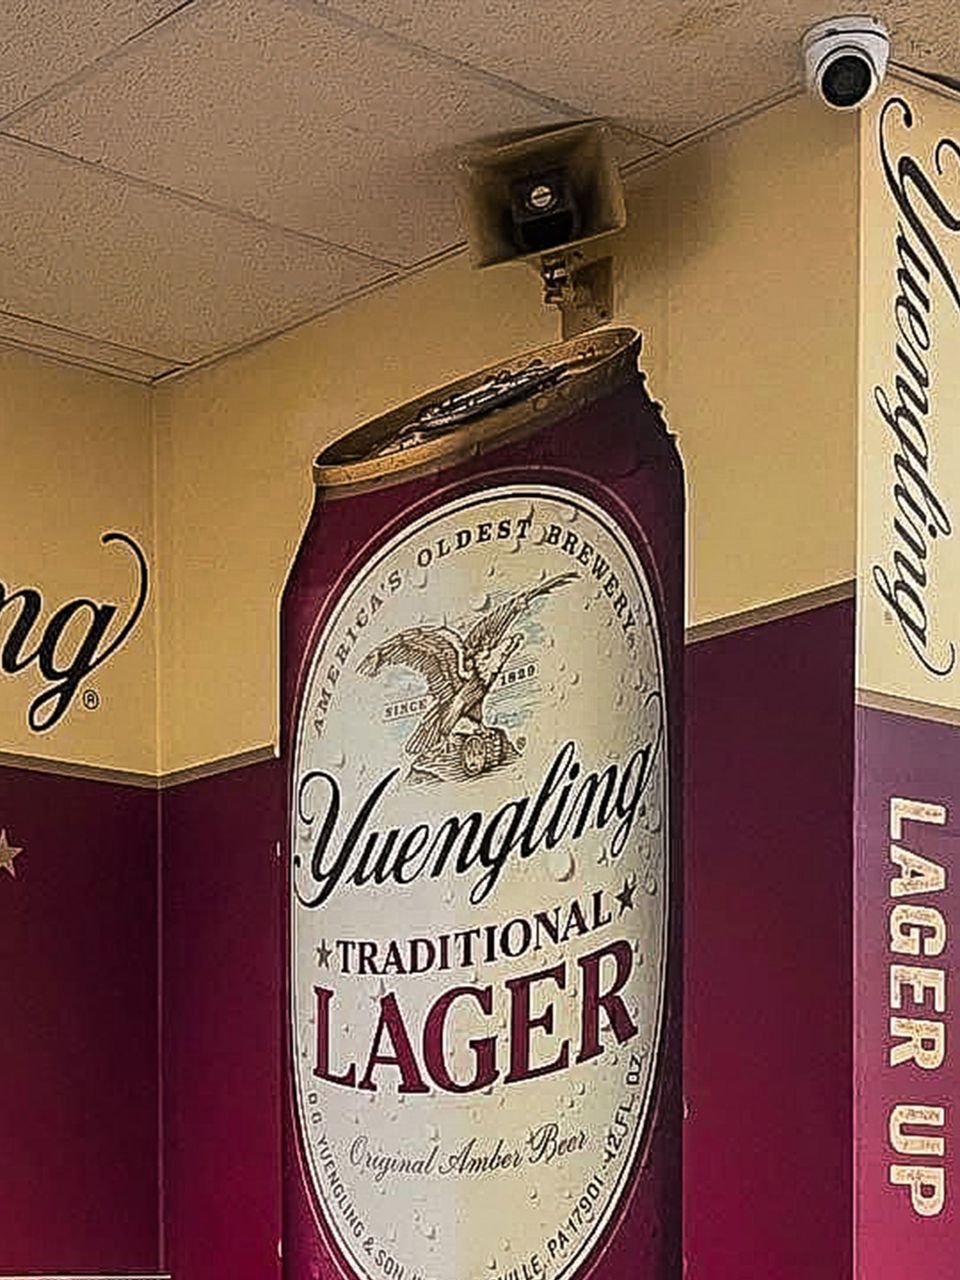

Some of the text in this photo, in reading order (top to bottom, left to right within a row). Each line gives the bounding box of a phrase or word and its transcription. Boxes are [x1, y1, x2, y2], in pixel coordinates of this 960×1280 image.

[417, 518, 531, 568] OLDEST
[294, 692, 663, 908] Yuengling
[336, 890, 612, 975] TRADITIONAL
[313, 939, 638, 1094] LAGER
[890, 797, 947, 1216] LAGER UP
[316, 1137, 366, 1238] YUENGLING
[547, 1230, 570, 1258] PA
[349, 1136, 437, 1180] Original
[439, 1138, 522, 1174] Amber
